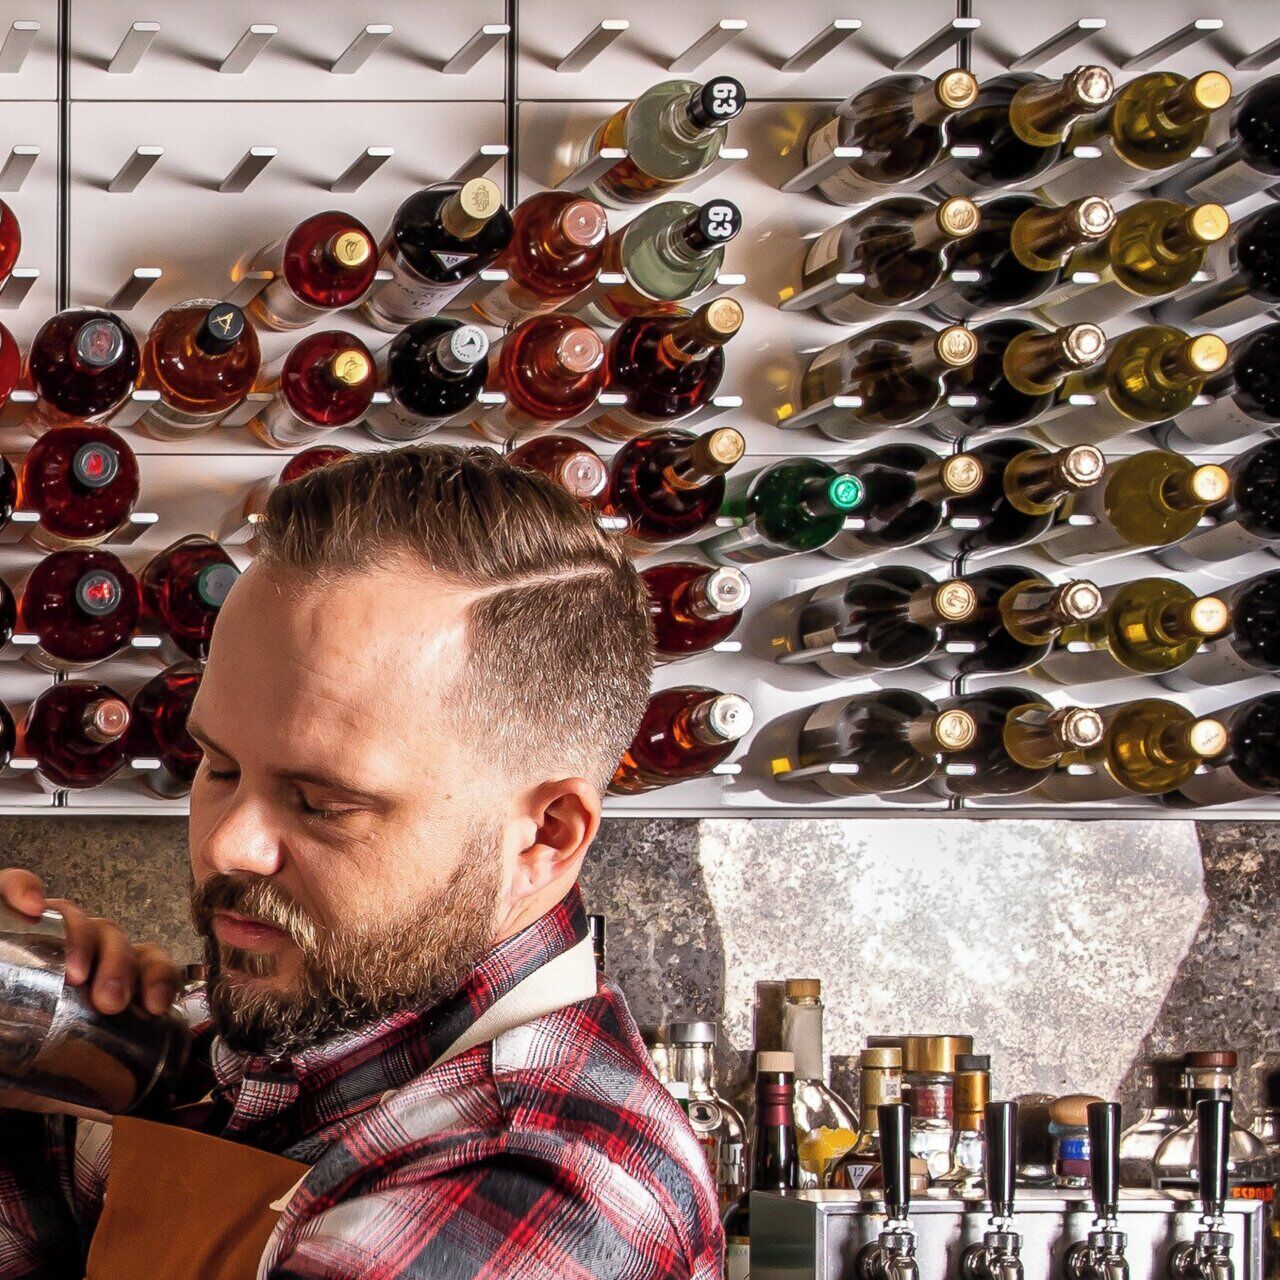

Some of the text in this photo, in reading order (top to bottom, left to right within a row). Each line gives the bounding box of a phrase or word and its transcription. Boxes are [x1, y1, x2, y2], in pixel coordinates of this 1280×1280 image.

[712, 83, 738, 114] 63
[707, 206, 733, 237] 63
[852, 1166, 865, 1177] 12
